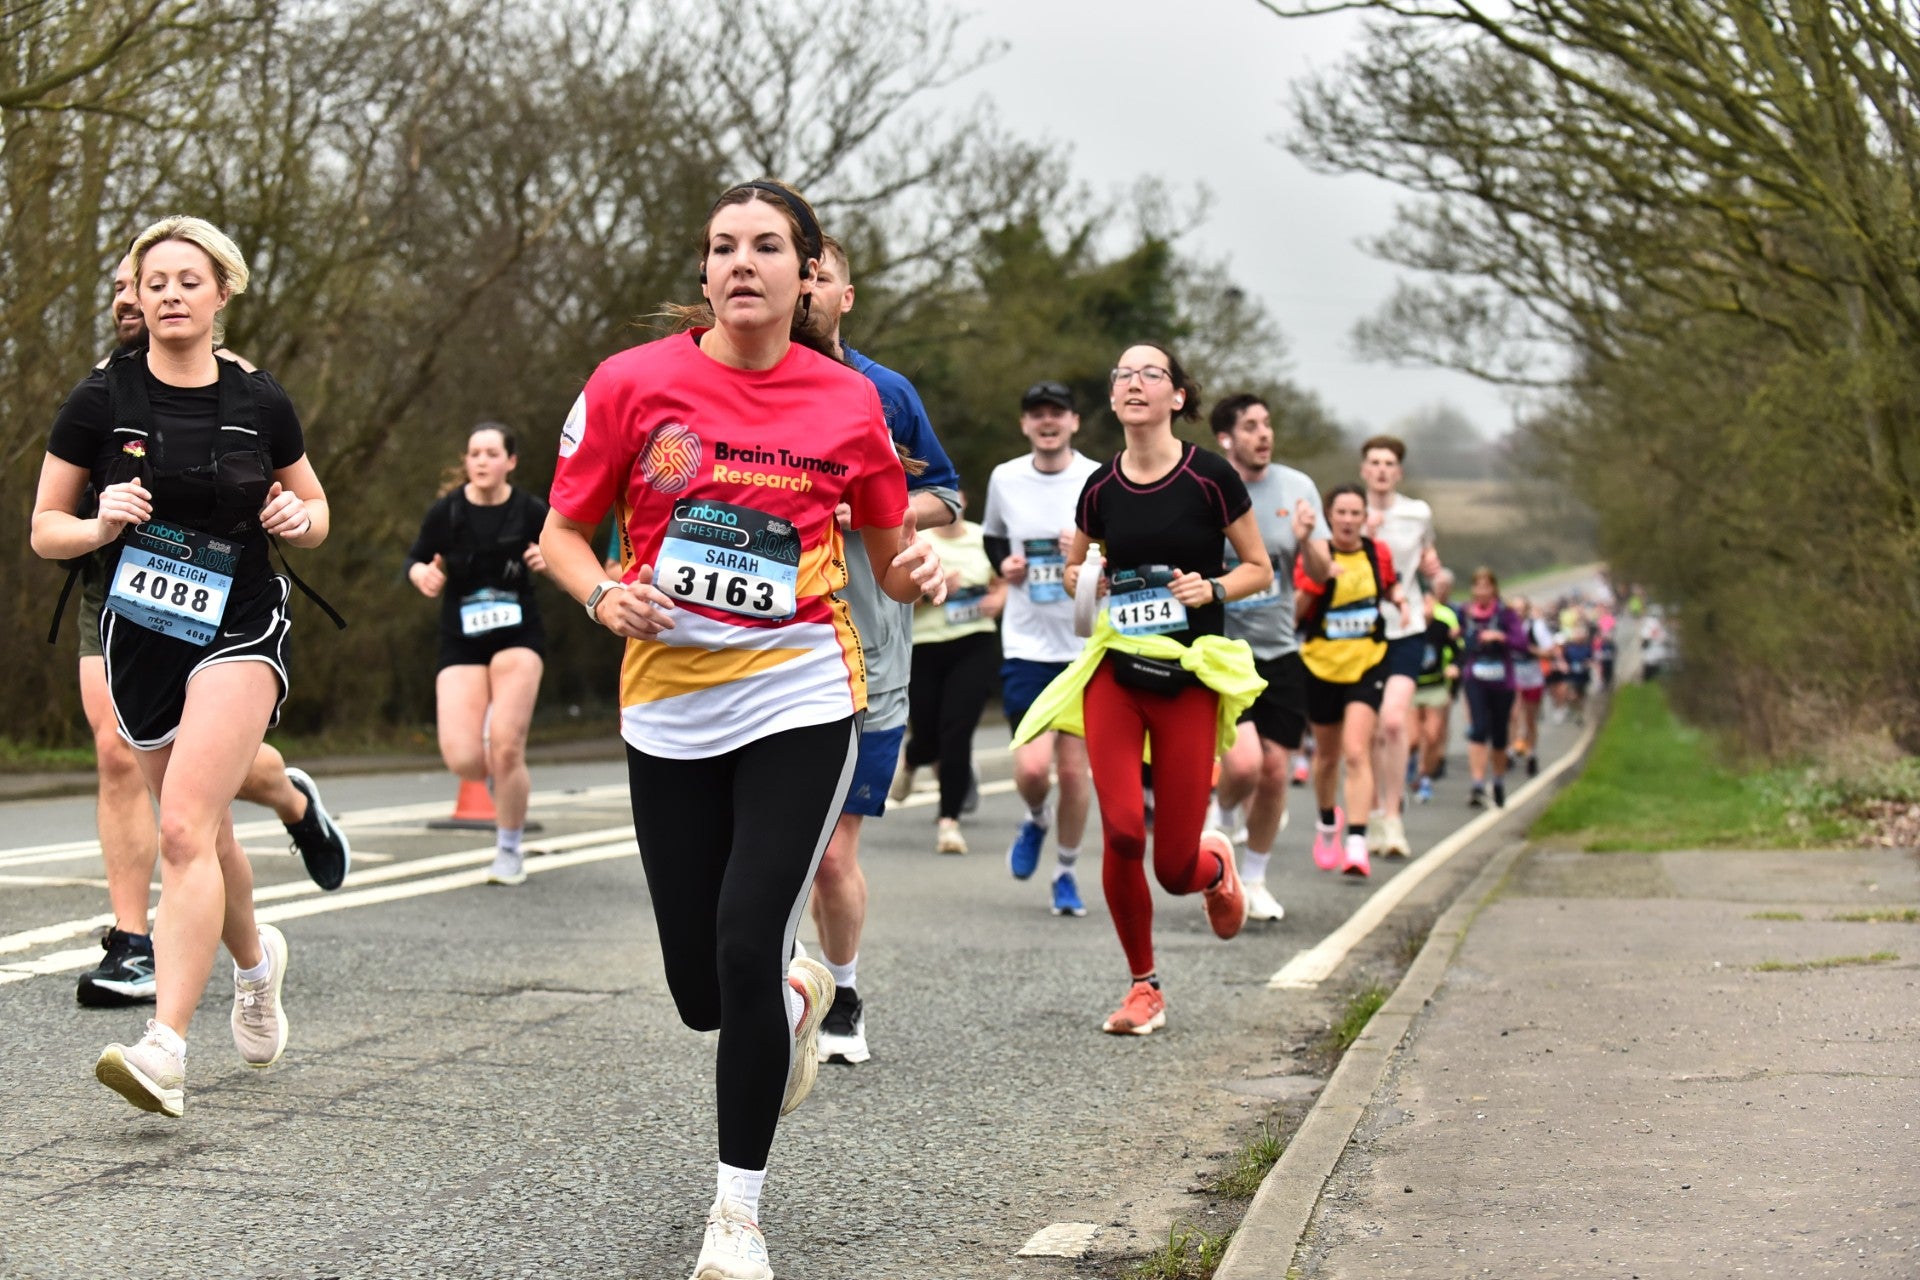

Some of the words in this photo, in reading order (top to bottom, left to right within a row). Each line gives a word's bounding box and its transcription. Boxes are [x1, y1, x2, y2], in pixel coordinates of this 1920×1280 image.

[715, 442, 775, 465] Brain
[778, 449, 849, 477] Tumour
[712, 464, 813, 493] Research
[688, 505, 738, 526] mbna
[147, 524, 185, 543] mbna
[680, 522, 737, 543] CHESTER
[751, 529, 798, 562] 10K
[140, 537, 183, 556] CHESTER
[193, 546, 236, 574] 10K
[705, 549, 759, 573] SARAH
[147, 556, 208, 584] ASHLEIGH
[129, 571, 209, 613] 4088
[674, 566, 774, 611] 3163
[1118, 601, 1171, 625] 4154
[185, 628, 211, 642] 4088
